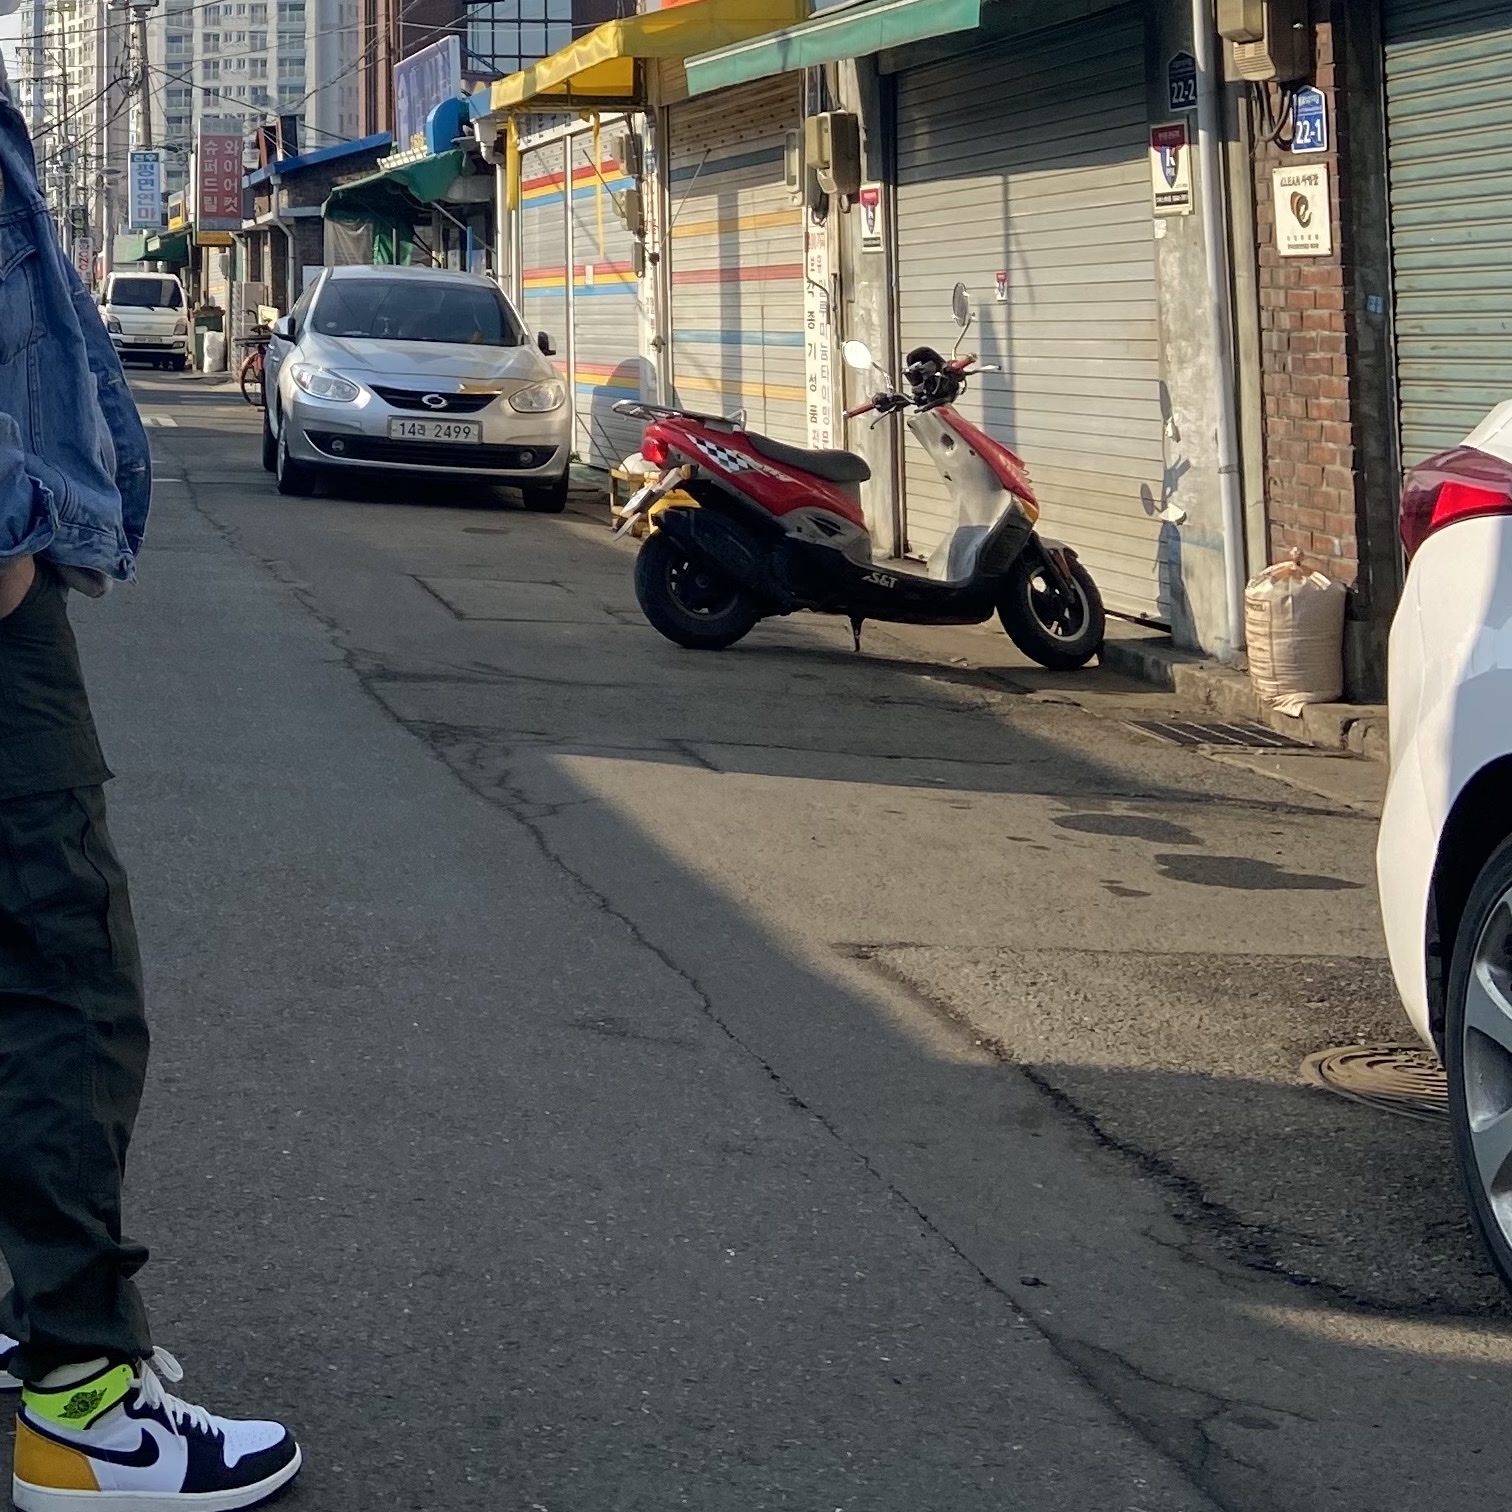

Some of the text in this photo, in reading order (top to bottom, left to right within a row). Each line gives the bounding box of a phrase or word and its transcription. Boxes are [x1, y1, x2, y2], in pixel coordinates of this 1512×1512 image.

[1171, 79, 1196, 104] 22-2
[1296, 119, 1322, 145] 22-1
[203, 140, 219, 213] 슈퍼드릴
[223, 140, 240, 213] 와이어컷
[434, 424, 471, 439] 2499
[866, 572, 898, 588] S&T
